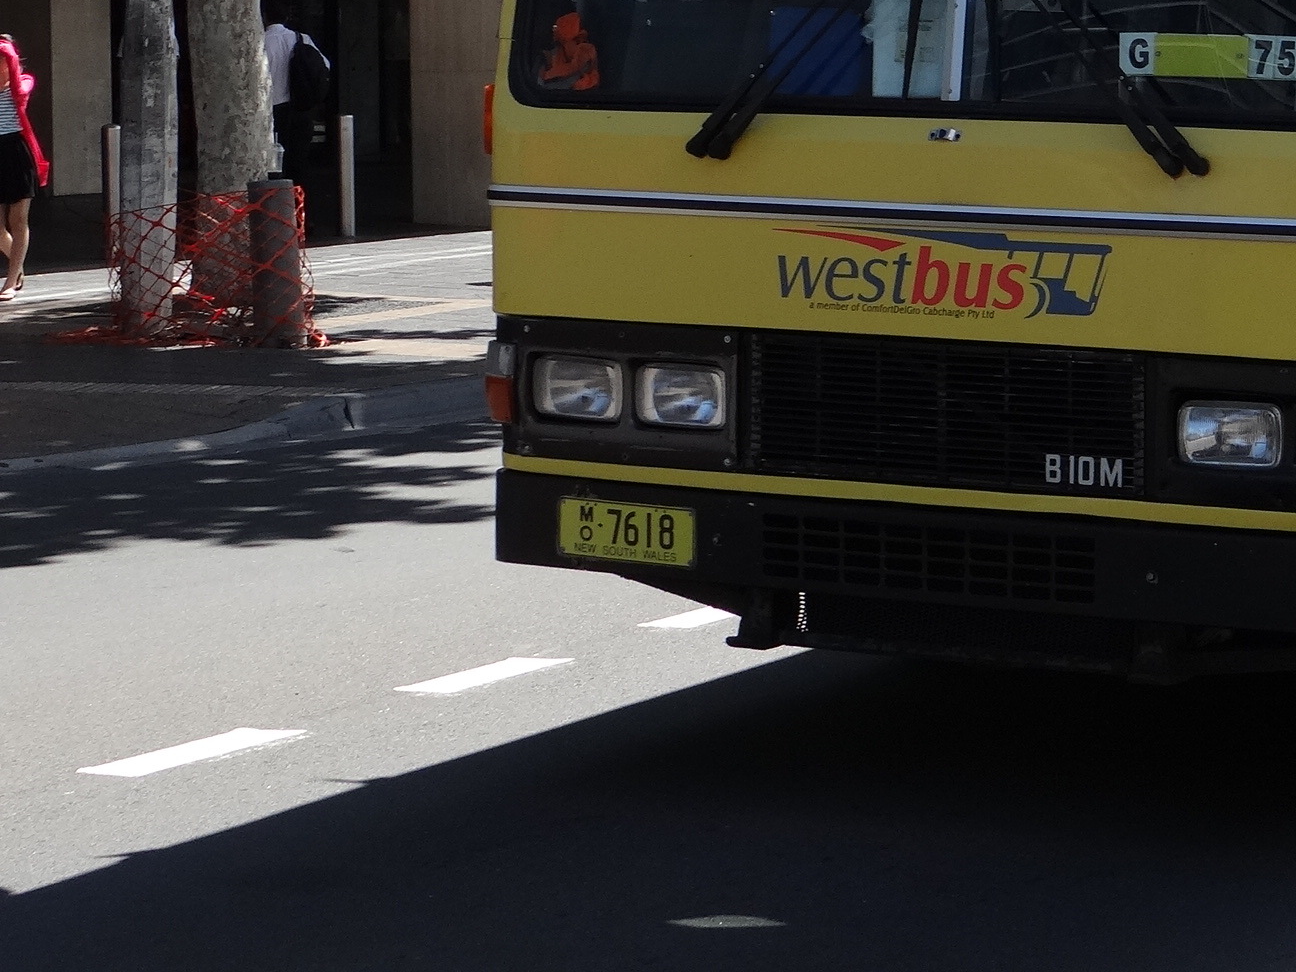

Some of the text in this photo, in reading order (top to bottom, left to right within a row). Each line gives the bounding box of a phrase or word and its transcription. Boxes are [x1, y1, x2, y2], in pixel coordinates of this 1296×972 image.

[1128, 37, 1150, 70] G
[776, 245, 1027, 311] westbus
[816, 301, 849, 311] member
[861, 304, 920, 315] ComfortDelGro
[923, 307, 965, 318] Cabcharge
[607, 509, 675, 550] 7618
[573, 542, 677, 562] NEW SOUTH WALES
